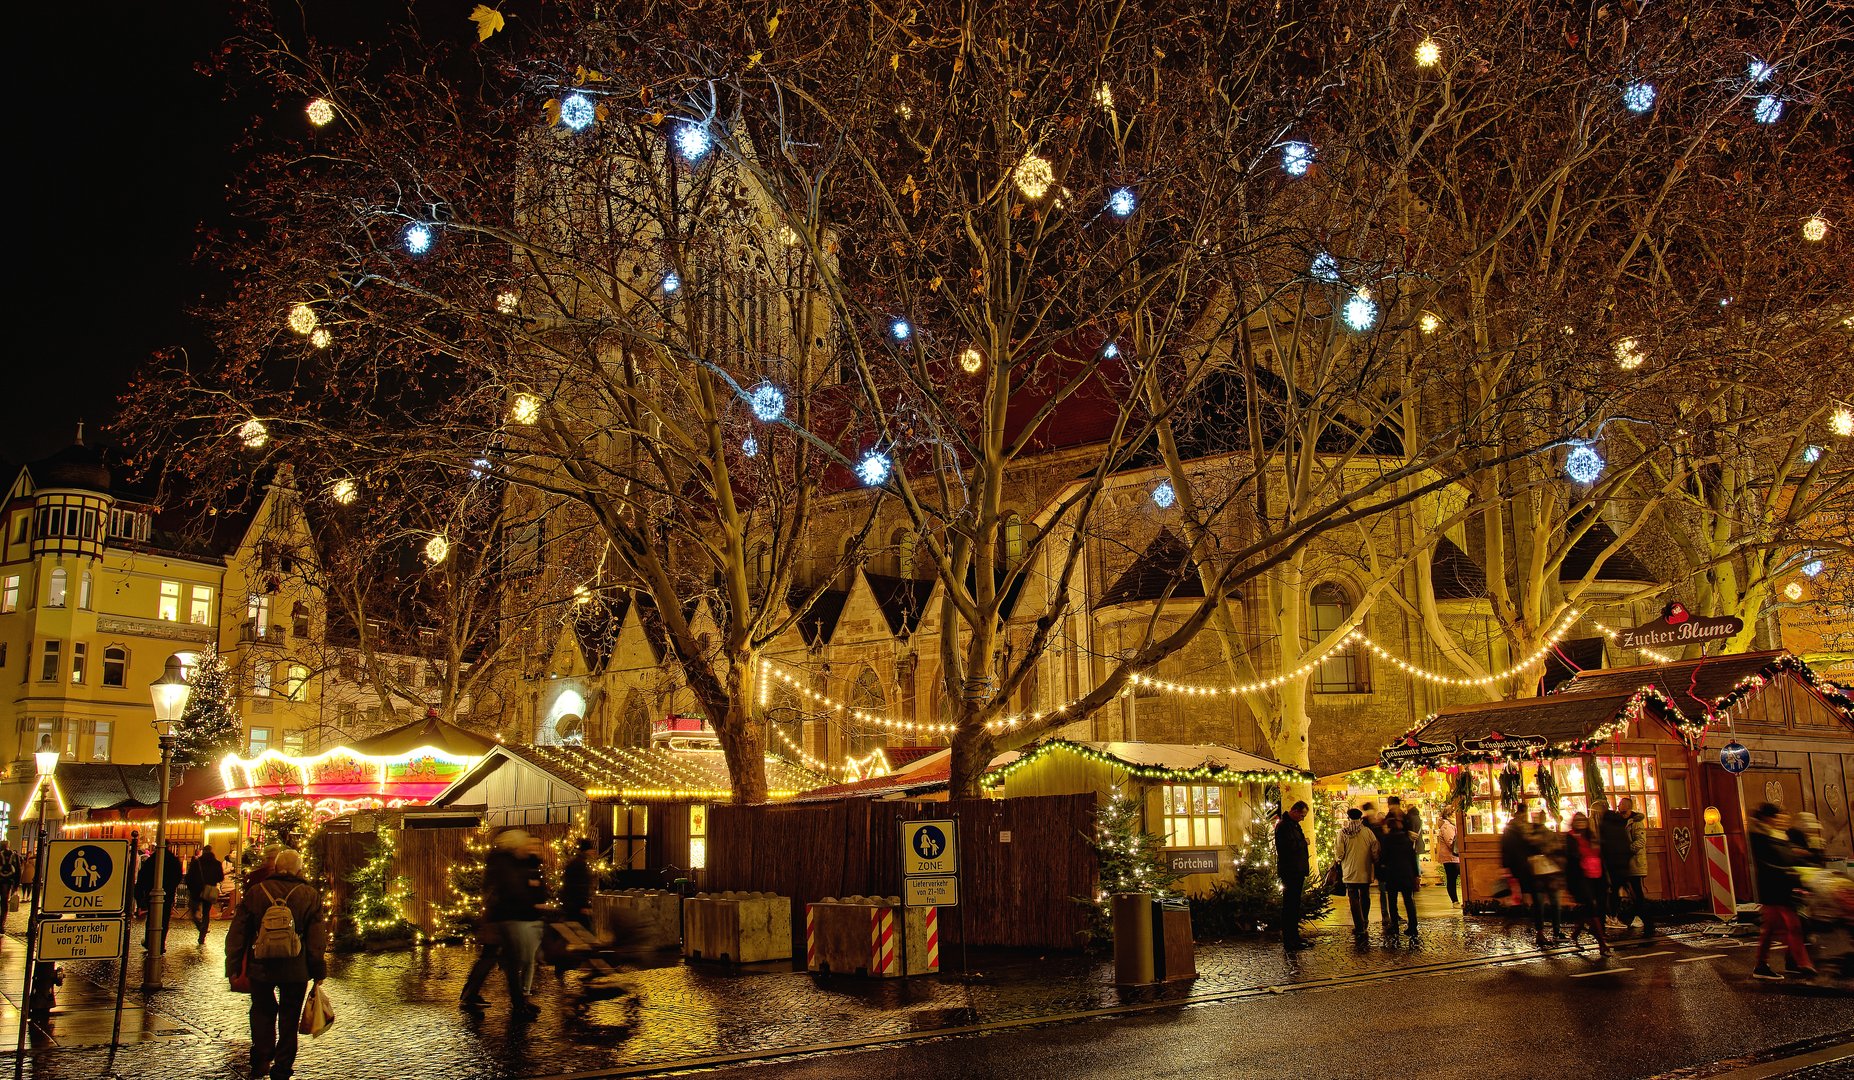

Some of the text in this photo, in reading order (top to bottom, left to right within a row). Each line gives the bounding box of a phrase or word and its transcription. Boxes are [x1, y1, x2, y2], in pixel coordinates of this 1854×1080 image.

[1624, 622, 1734, 647] Zucker Blume
[918, 861, 943, 870] ZONE
[1172, 857, 1214, 869] Förtchen
[63, 896, 103, 907] ZONE
[51, 923, 109, 934] Lieferverkehr
[57, 937, 72, 945] von
[71, 946, 87, 956] frei
